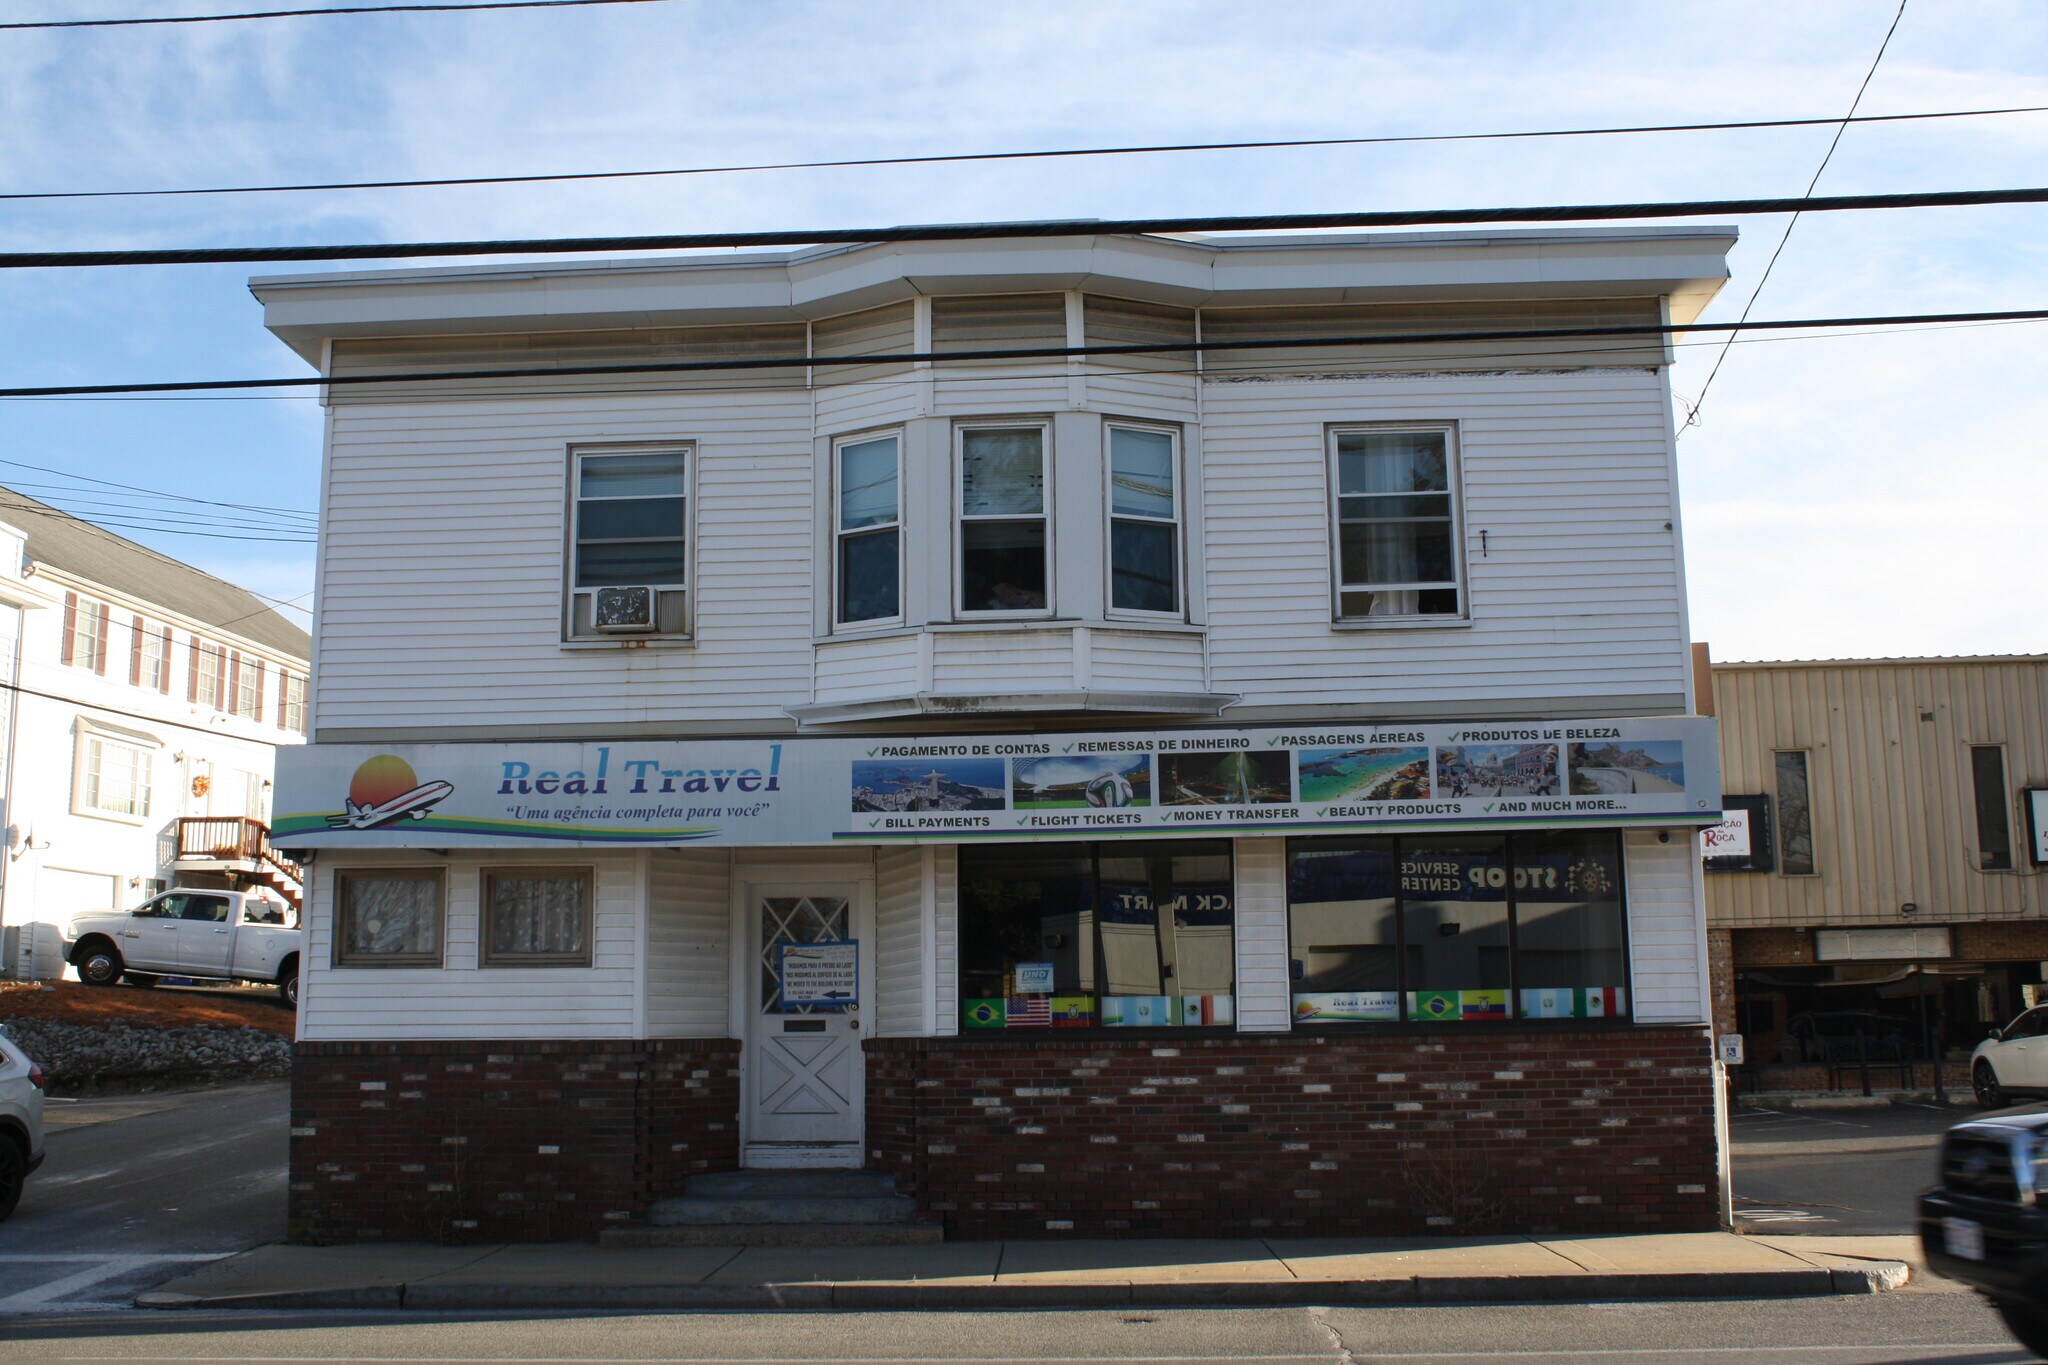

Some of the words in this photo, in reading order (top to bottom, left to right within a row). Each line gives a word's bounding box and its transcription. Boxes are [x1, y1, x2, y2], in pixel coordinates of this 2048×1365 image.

[1281, 734, 1365, 746] PASSAGENS
[1370, 732, 1425, 744] AEREAS
[1462, 730, 1538, 742] PRODUTOS
[1543, 730, 1561, 740] DE
[1566, 728, 1620, 739] BELEZA
[882, 746, 968, 756] PAGAMENTO
[972, 745, 990, 755] DE
[994, 744, 1050, 754] CONTAS
[1078, 741, 1154, 752] REMESSAS
[1158, 740, 1177, 750] DE
[1182, 738, 1250, 750] DINHEIRO
[497, 747, 609, 794] Real
[624, 744, 782, 793] Travel
[1330, 806, 1384, 816] BEAUTY
[1388, 804, 1462, 815] PRODUCTS
[1499, 802, 1528, 812] AND
[1531, 802, 1572, 812] MUCH
[1576, 800, 1626, 811] MORE...
[554, 806, 610, 822] agência
[616, 804, 682, 822] completa
[686, 807, 721, 820] para
[1174, 810, 1222, 821] MONEY
[1227, 808, 1299, 820] TRANSFER
[886, 818, 915, 828] BILL
[918, 817, 990, 828] PAYMENTS
[1031, 816, 1080, 826] FLIGHT
[1084, 814, 1142, 824] TICKETS
[1333, 998, 1358, 1006] Real
[1362, 996, 1397, 1006] Travel
